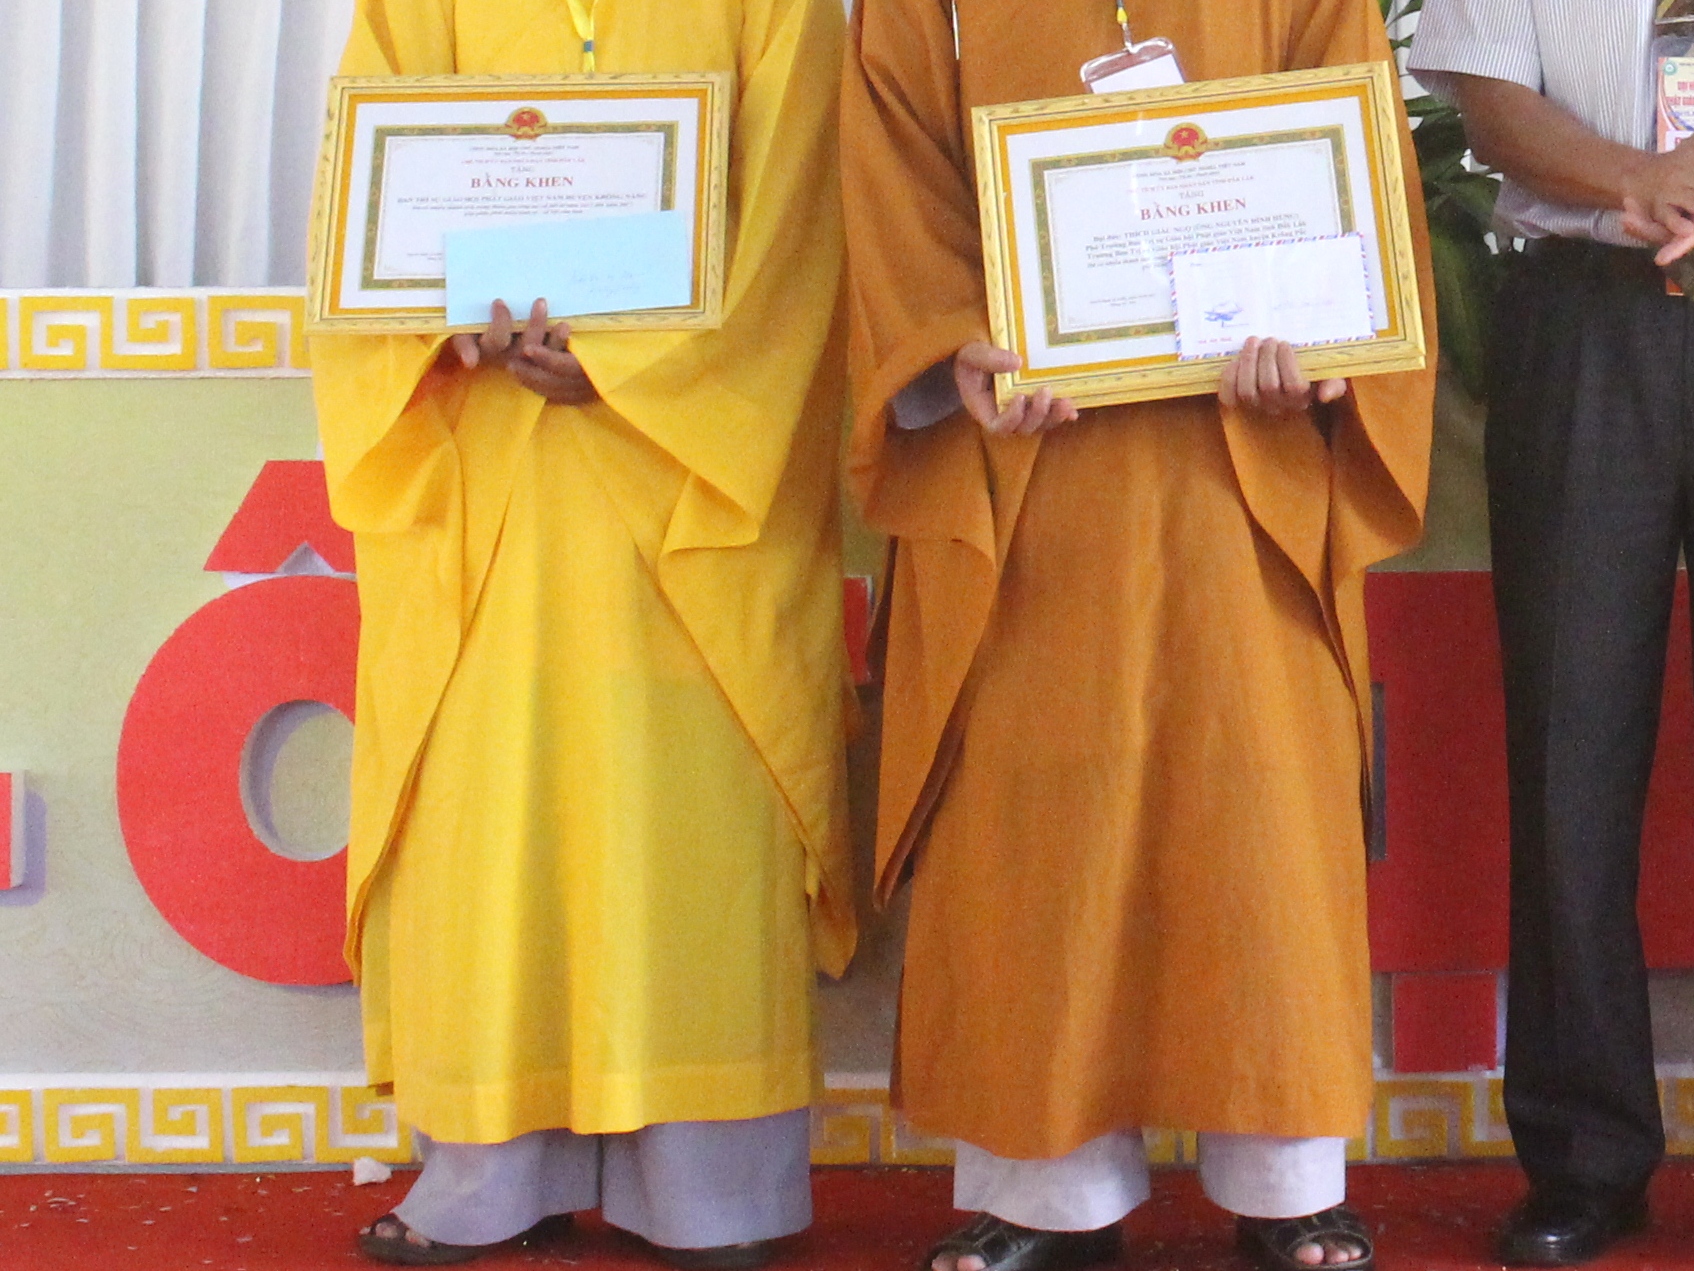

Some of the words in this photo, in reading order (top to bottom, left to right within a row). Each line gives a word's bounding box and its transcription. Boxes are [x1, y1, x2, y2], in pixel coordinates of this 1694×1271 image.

[470, 172, 519, 189] BẰNG
[525, 176, 574, 188] KHEN
[1140, 197, 1190, 221] BẰNG
[1196, 198, 1247, 216] KHEN
